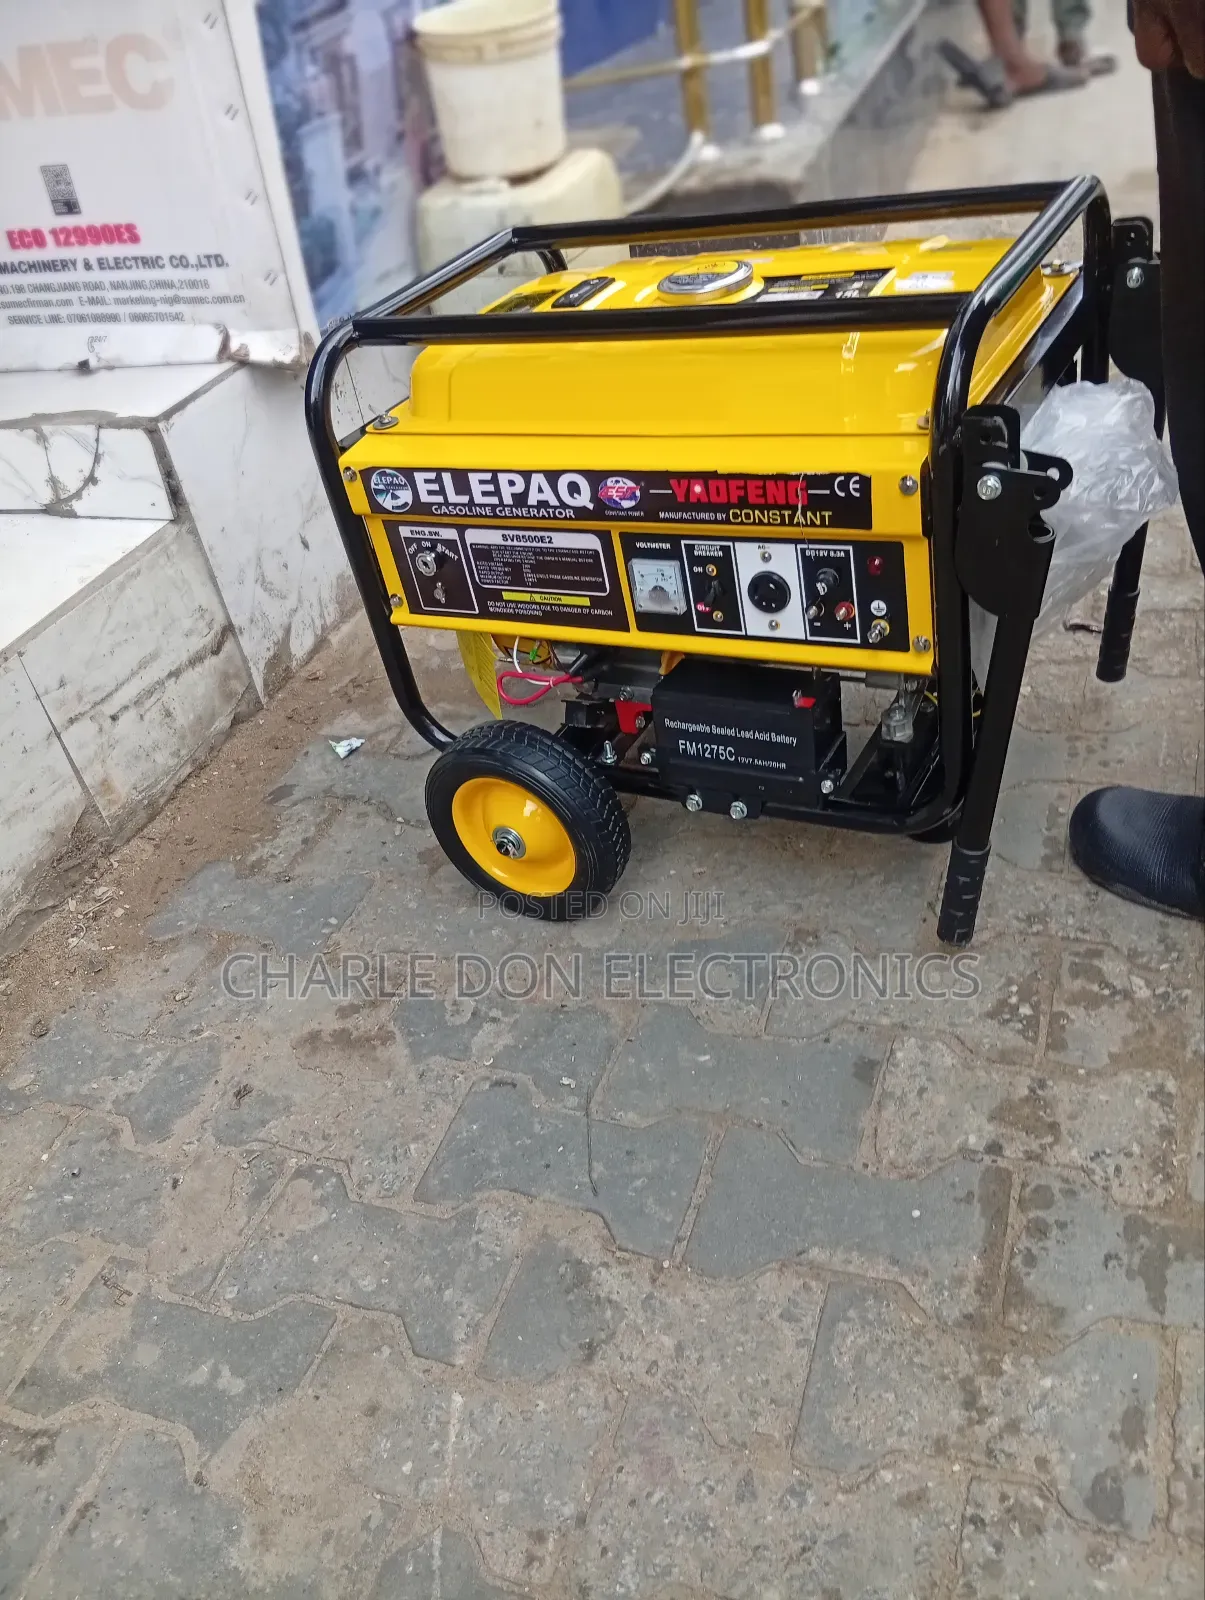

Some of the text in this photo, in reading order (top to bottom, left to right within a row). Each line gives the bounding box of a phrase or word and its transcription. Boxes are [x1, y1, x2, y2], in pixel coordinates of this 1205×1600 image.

[6, 223, 141, 250] ECO 12990ES
[0, 254, 229, 275] MACHINERY & ELECTRIC CO.,LTD.
[27, 281, 82, 293] CHANGJIANG
[8, 315, 44, 325] SERVICE
[413, 472, 595, 511] ELEPAQ
[669, 479, 808, 505] YAOFENG
[431, 505, 576, 519] GASOLINE GENERATOR
[659, 508, 833, 526] MANUFACTURED BY CONSTANT
[410, 529, 443, 538] ENG.SW.
[501, 533, 554, 545] SV8500E2
[408, 543, 418, 554] OFF
[436, 543, 459, 562] START
[635, 542, 671, 550] VOLTMETER
[664, 717, 797, 747] Rechargeable Sealed Lead Acid Battery
[678, 739, 735, 761] FM1275C
